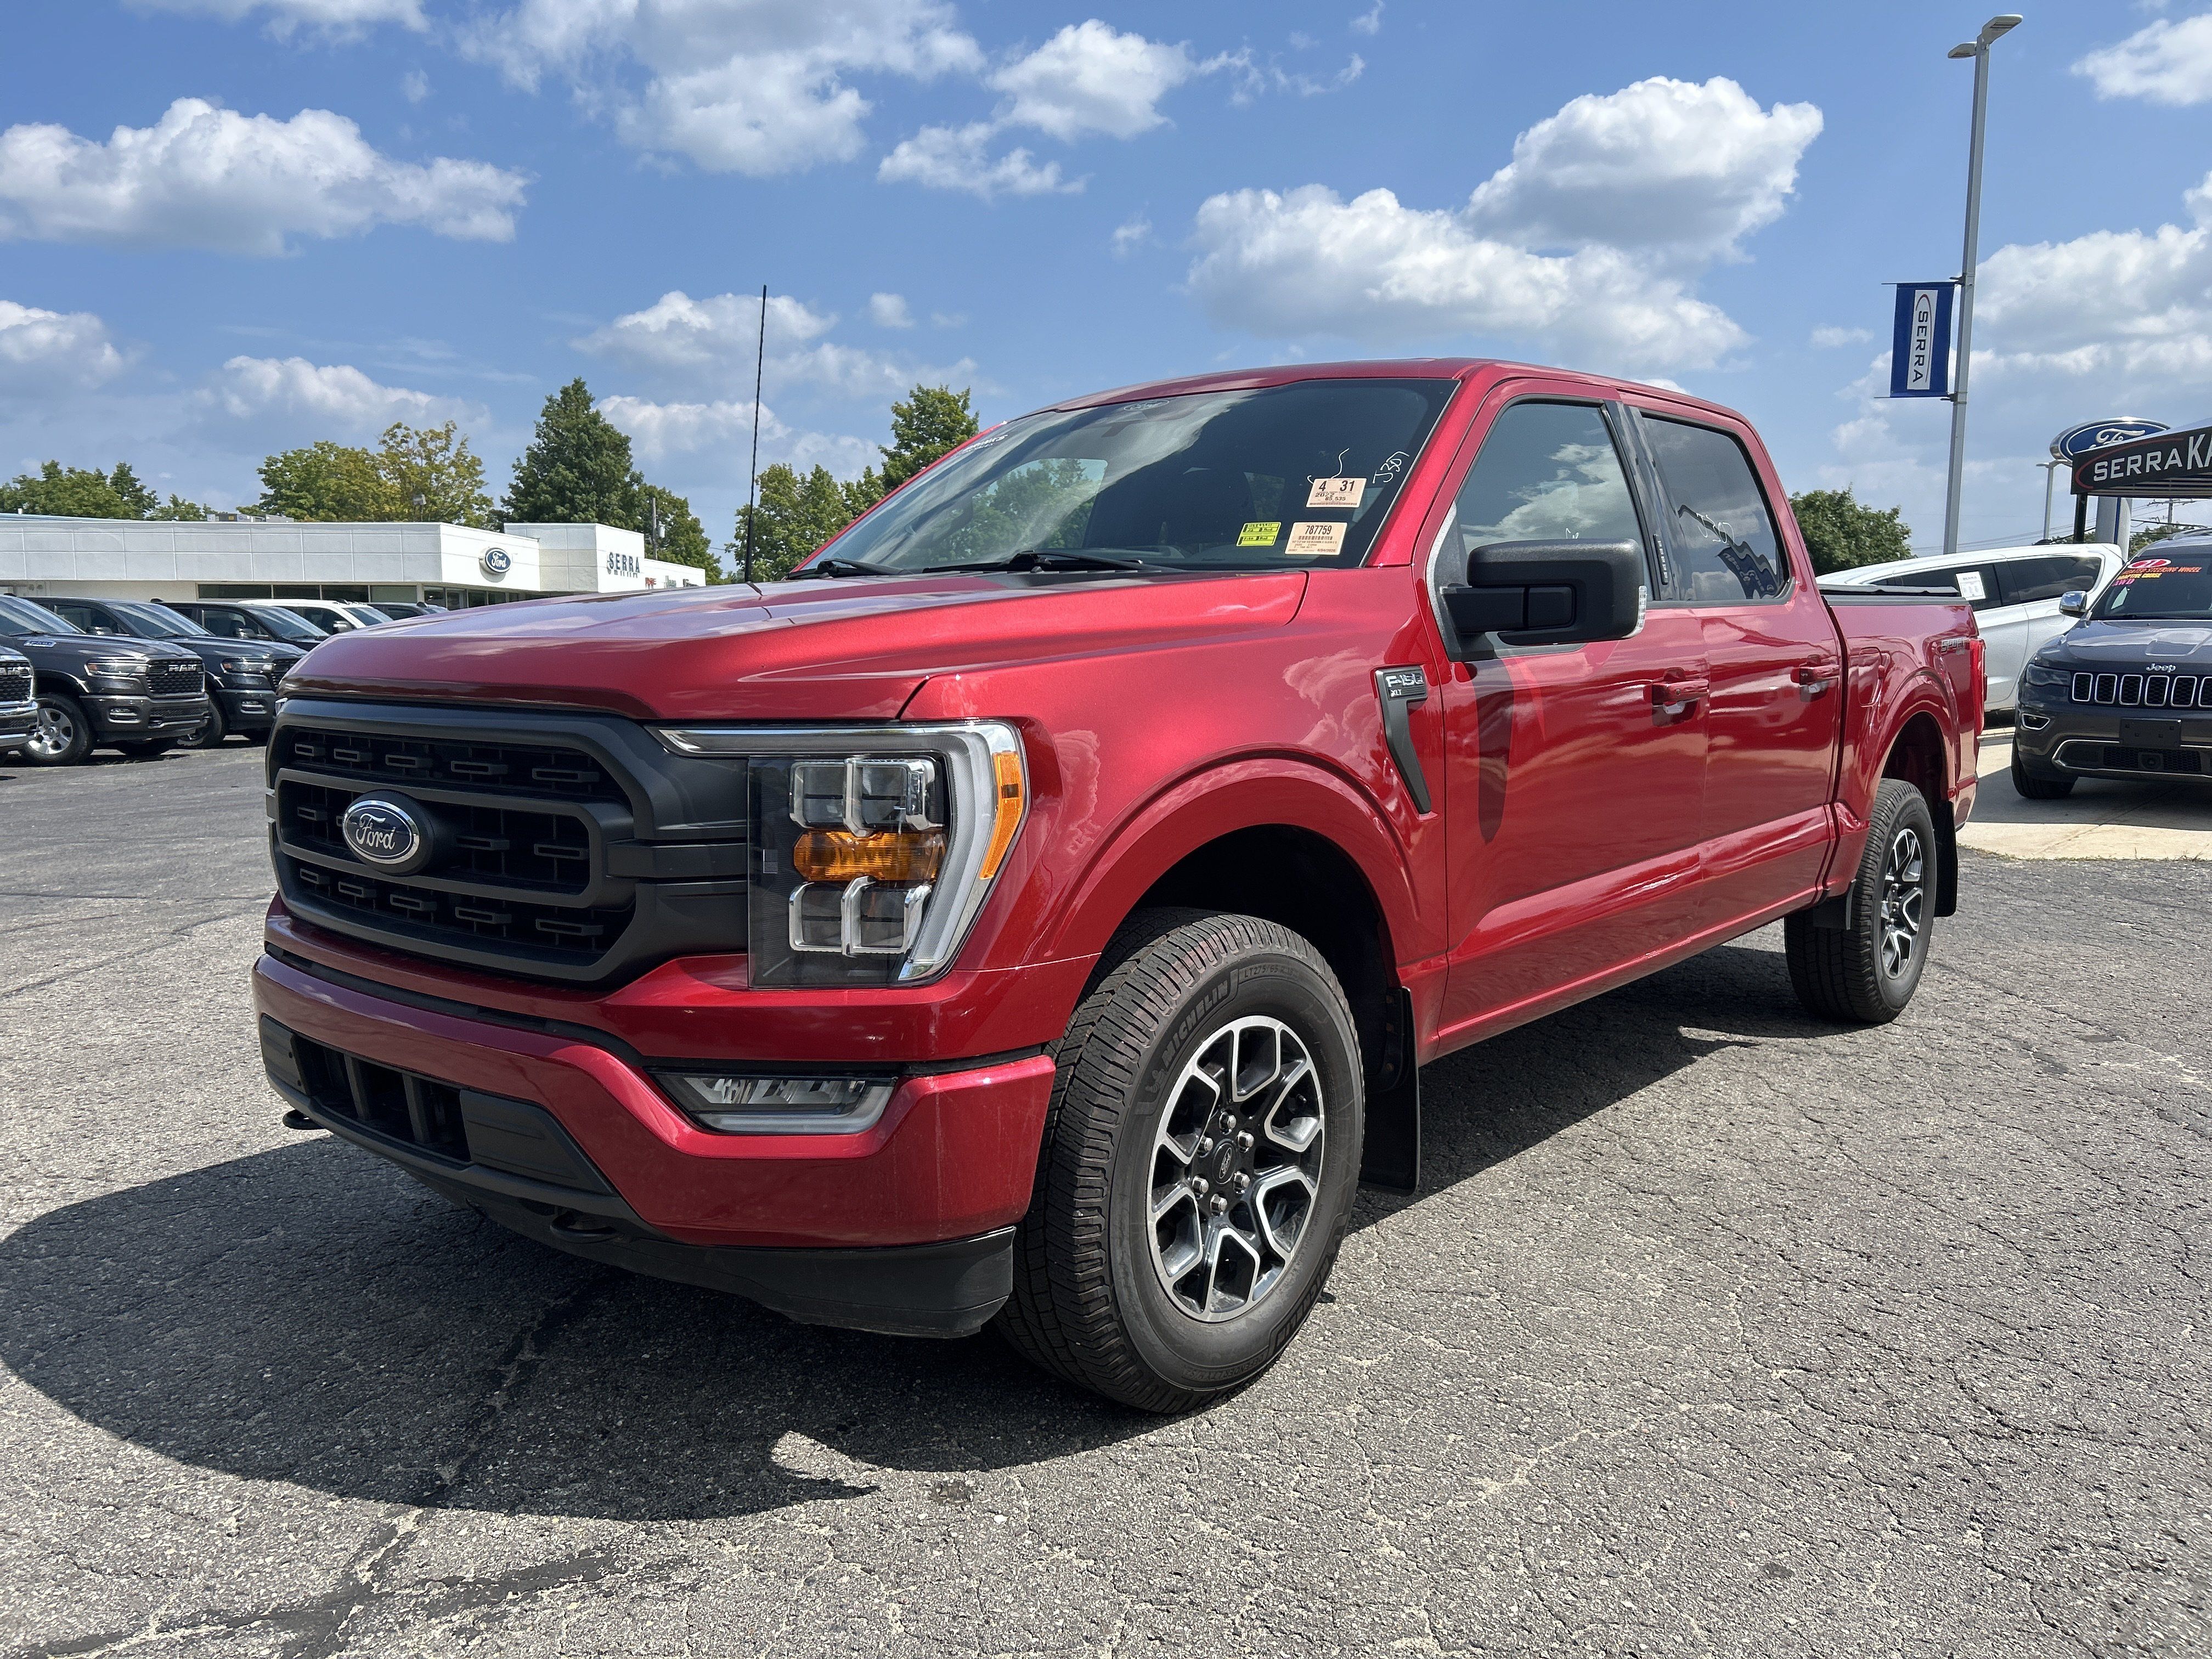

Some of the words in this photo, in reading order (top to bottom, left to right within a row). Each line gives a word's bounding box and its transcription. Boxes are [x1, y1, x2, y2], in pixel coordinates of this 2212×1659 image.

[1912, 311, 1928, 383] SERRA
[2094, 448, 2183, 482] SERRA
[1318, 480, 1327, 492] 4
[1340, 480, 1355, 492] 31
[1305, 525, 1332, 535] 787759
[491, 551, 506, 568] Ford
[609, 552, 640, 573] SERRA
[2146, 663, 2176, 673] Jeep
[1386, 673, 1424, 687] F-150
[1390, 689, 1402, 697] XLT
[356, 813, 396, 850] Ford
[1161, 979, 1228, 1068] MICHELIN
